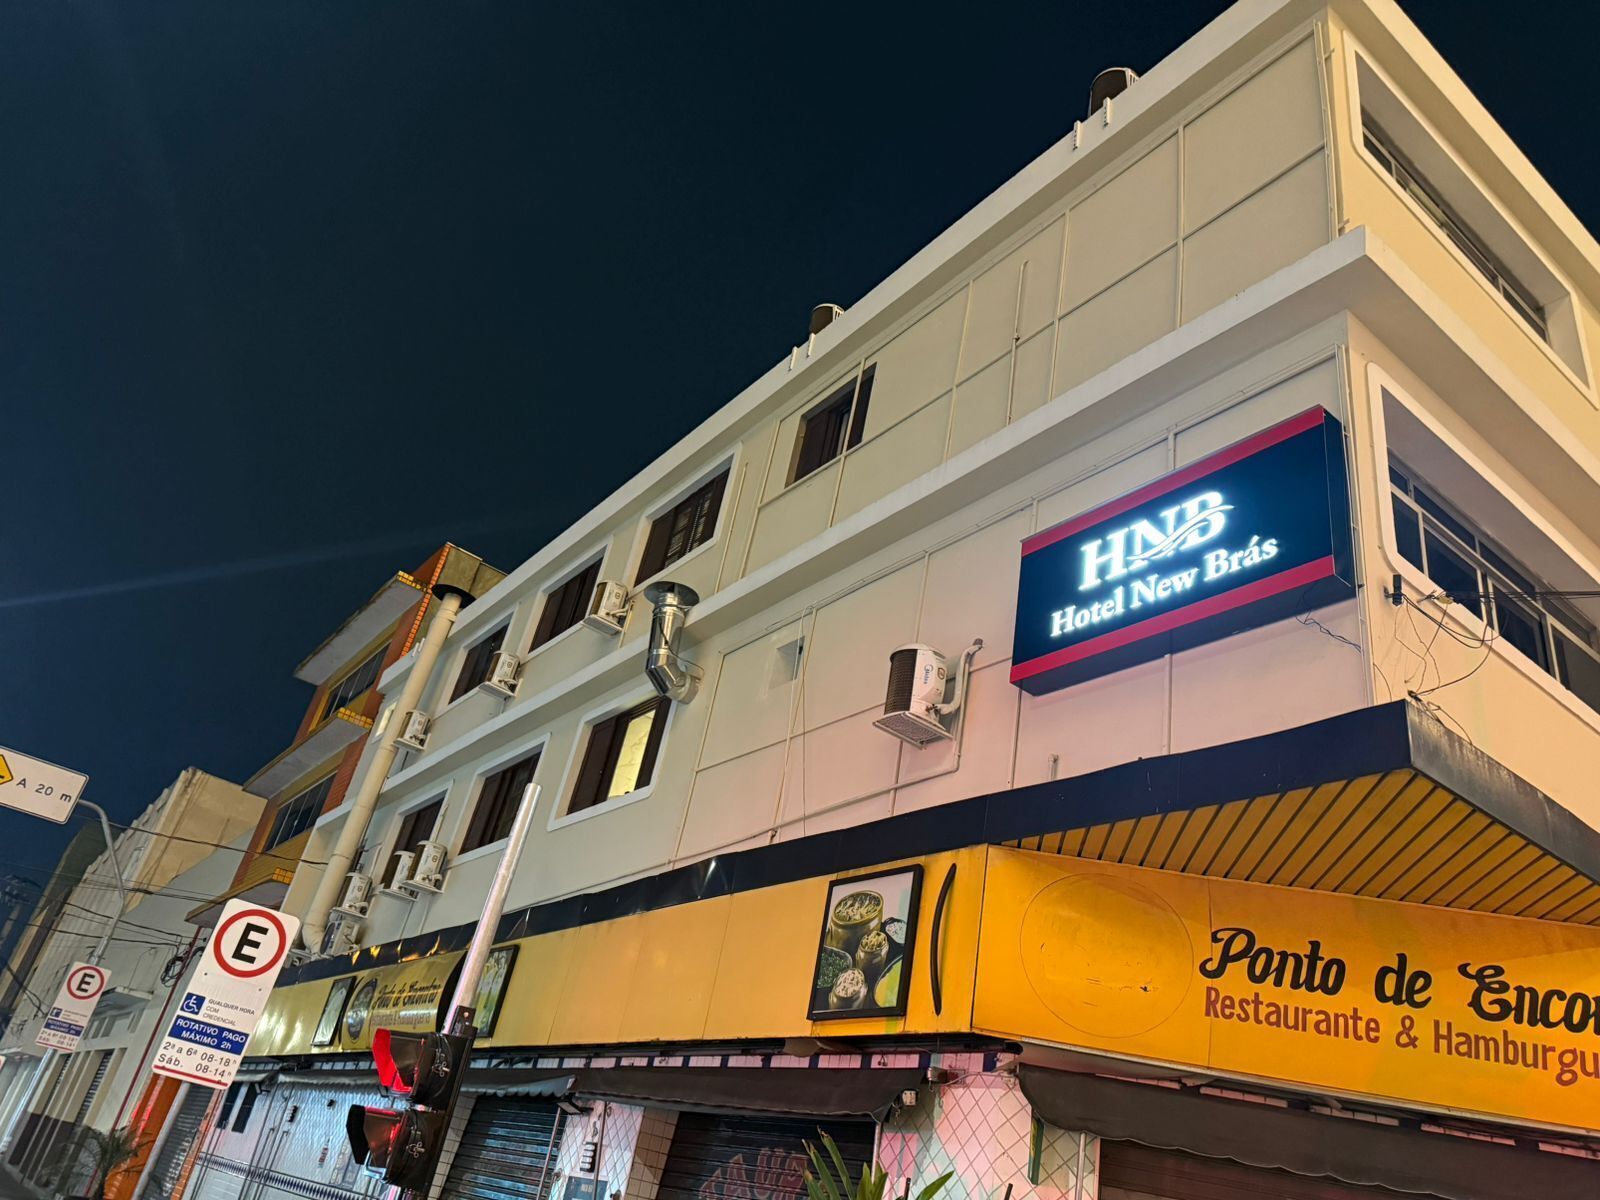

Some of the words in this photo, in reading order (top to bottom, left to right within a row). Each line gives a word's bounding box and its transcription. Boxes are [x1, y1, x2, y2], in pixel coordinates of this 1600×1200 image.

[1078, 491, 1228, 591] HNB
[1049, 586, 1126, 637] Hotel
[1129, 568, 1199, 609] New
[1203, 534, 1279, 582] Brás
[16, 777, 27, 789] A
[35, 783, 54, 796] 20
[59, 793, 72, 803] m
[231, 922, 269, 965] E
[1199, 927, 1346, 996] Ponto
[1374, 952, 1432, 1009] de
[76, 972, 95, 993] E
[208, 998, 239, 1012] QUALQUER
[239, 1007, 255, 1015] HORA
[1204, 986, 1380, 1044] Restaurante
[1395, 1014, 1419, 1049] &
[176, 1018, 218, 1035] ROTATIVO
[222, 1031, 246, 1043] PAGO
[202, 1013, 236, 1026] CREDENCIAL
[181, 1029, 218, 1046] MÁXIMO
[220, 1041, 232, 1050] 2h
[158, 1053, 183, 1068] Sáb.
